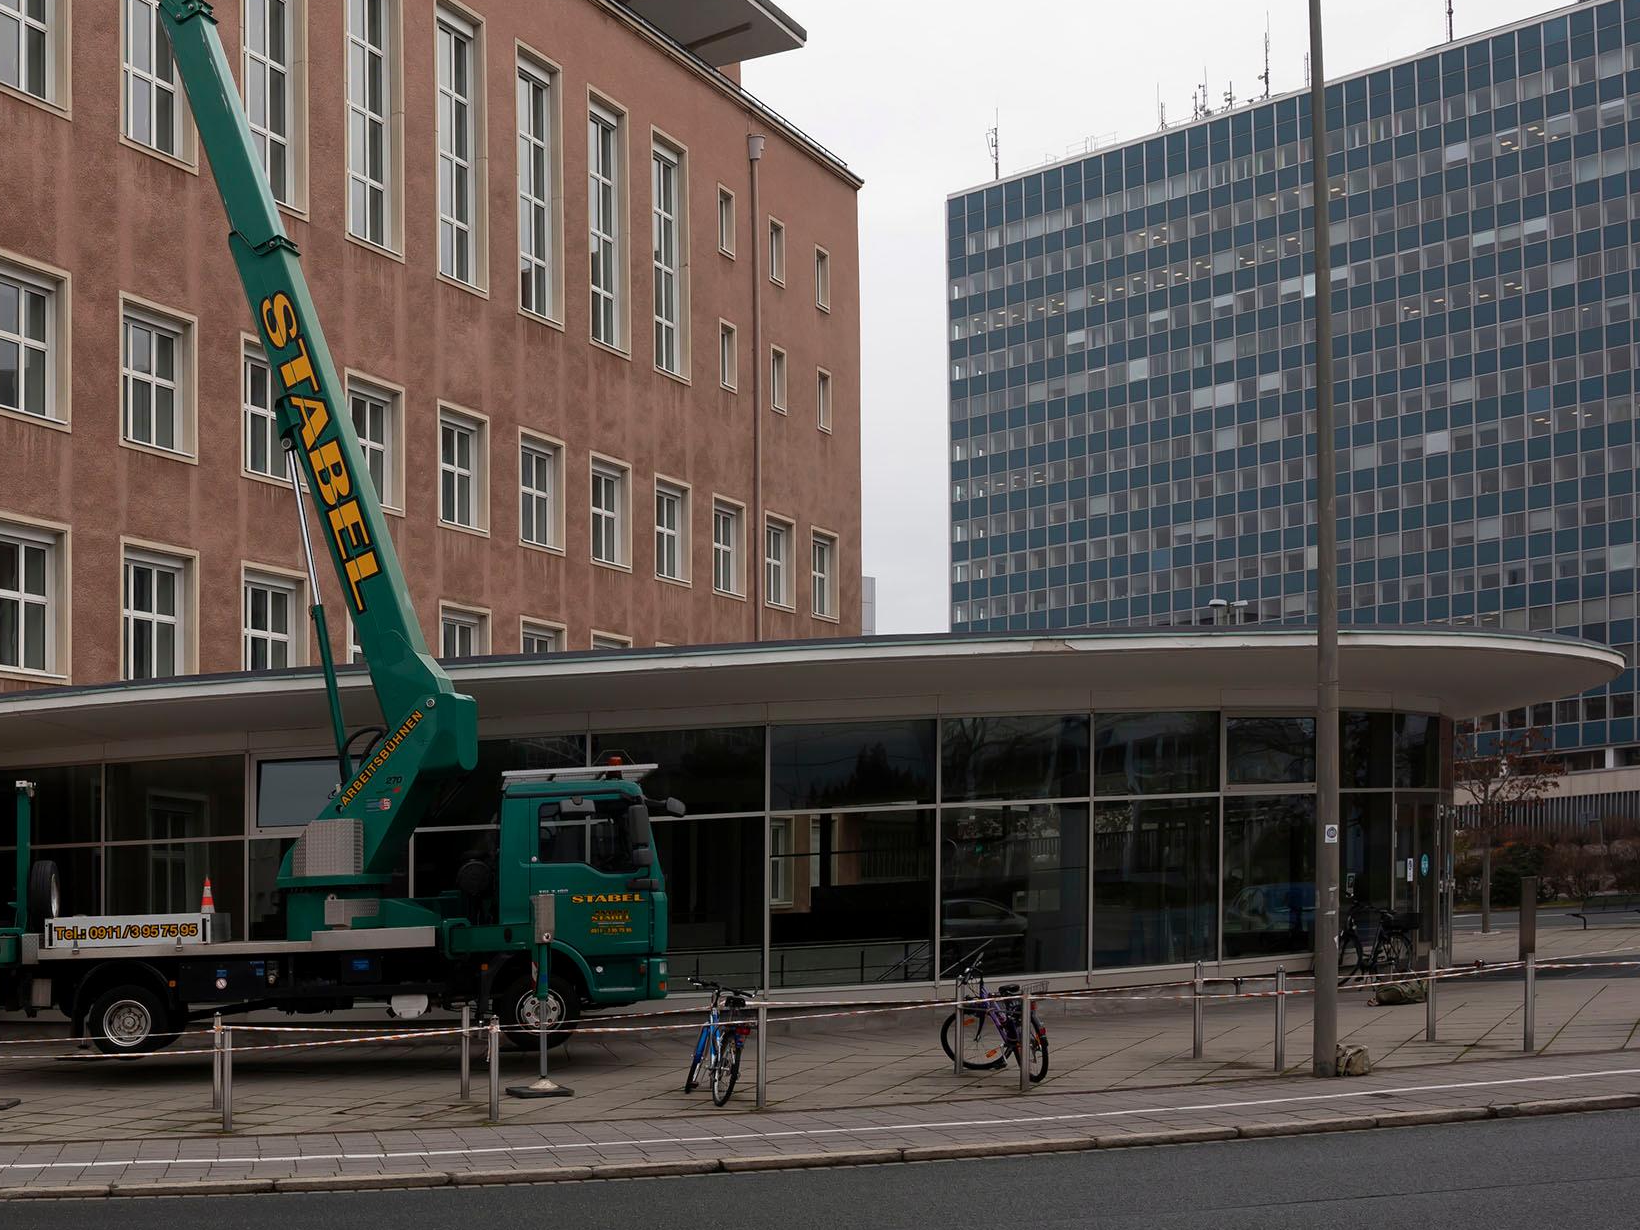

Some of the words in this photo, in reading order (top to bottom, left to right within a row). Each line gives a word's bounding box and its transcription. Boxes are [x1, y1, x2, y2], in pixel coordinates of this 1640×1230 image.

[260, 290, 383, 614] STABEL
[340, 709, 424, 807] ARBEITSBÜHNEN
[571, 894, 645, 903] STABEL
